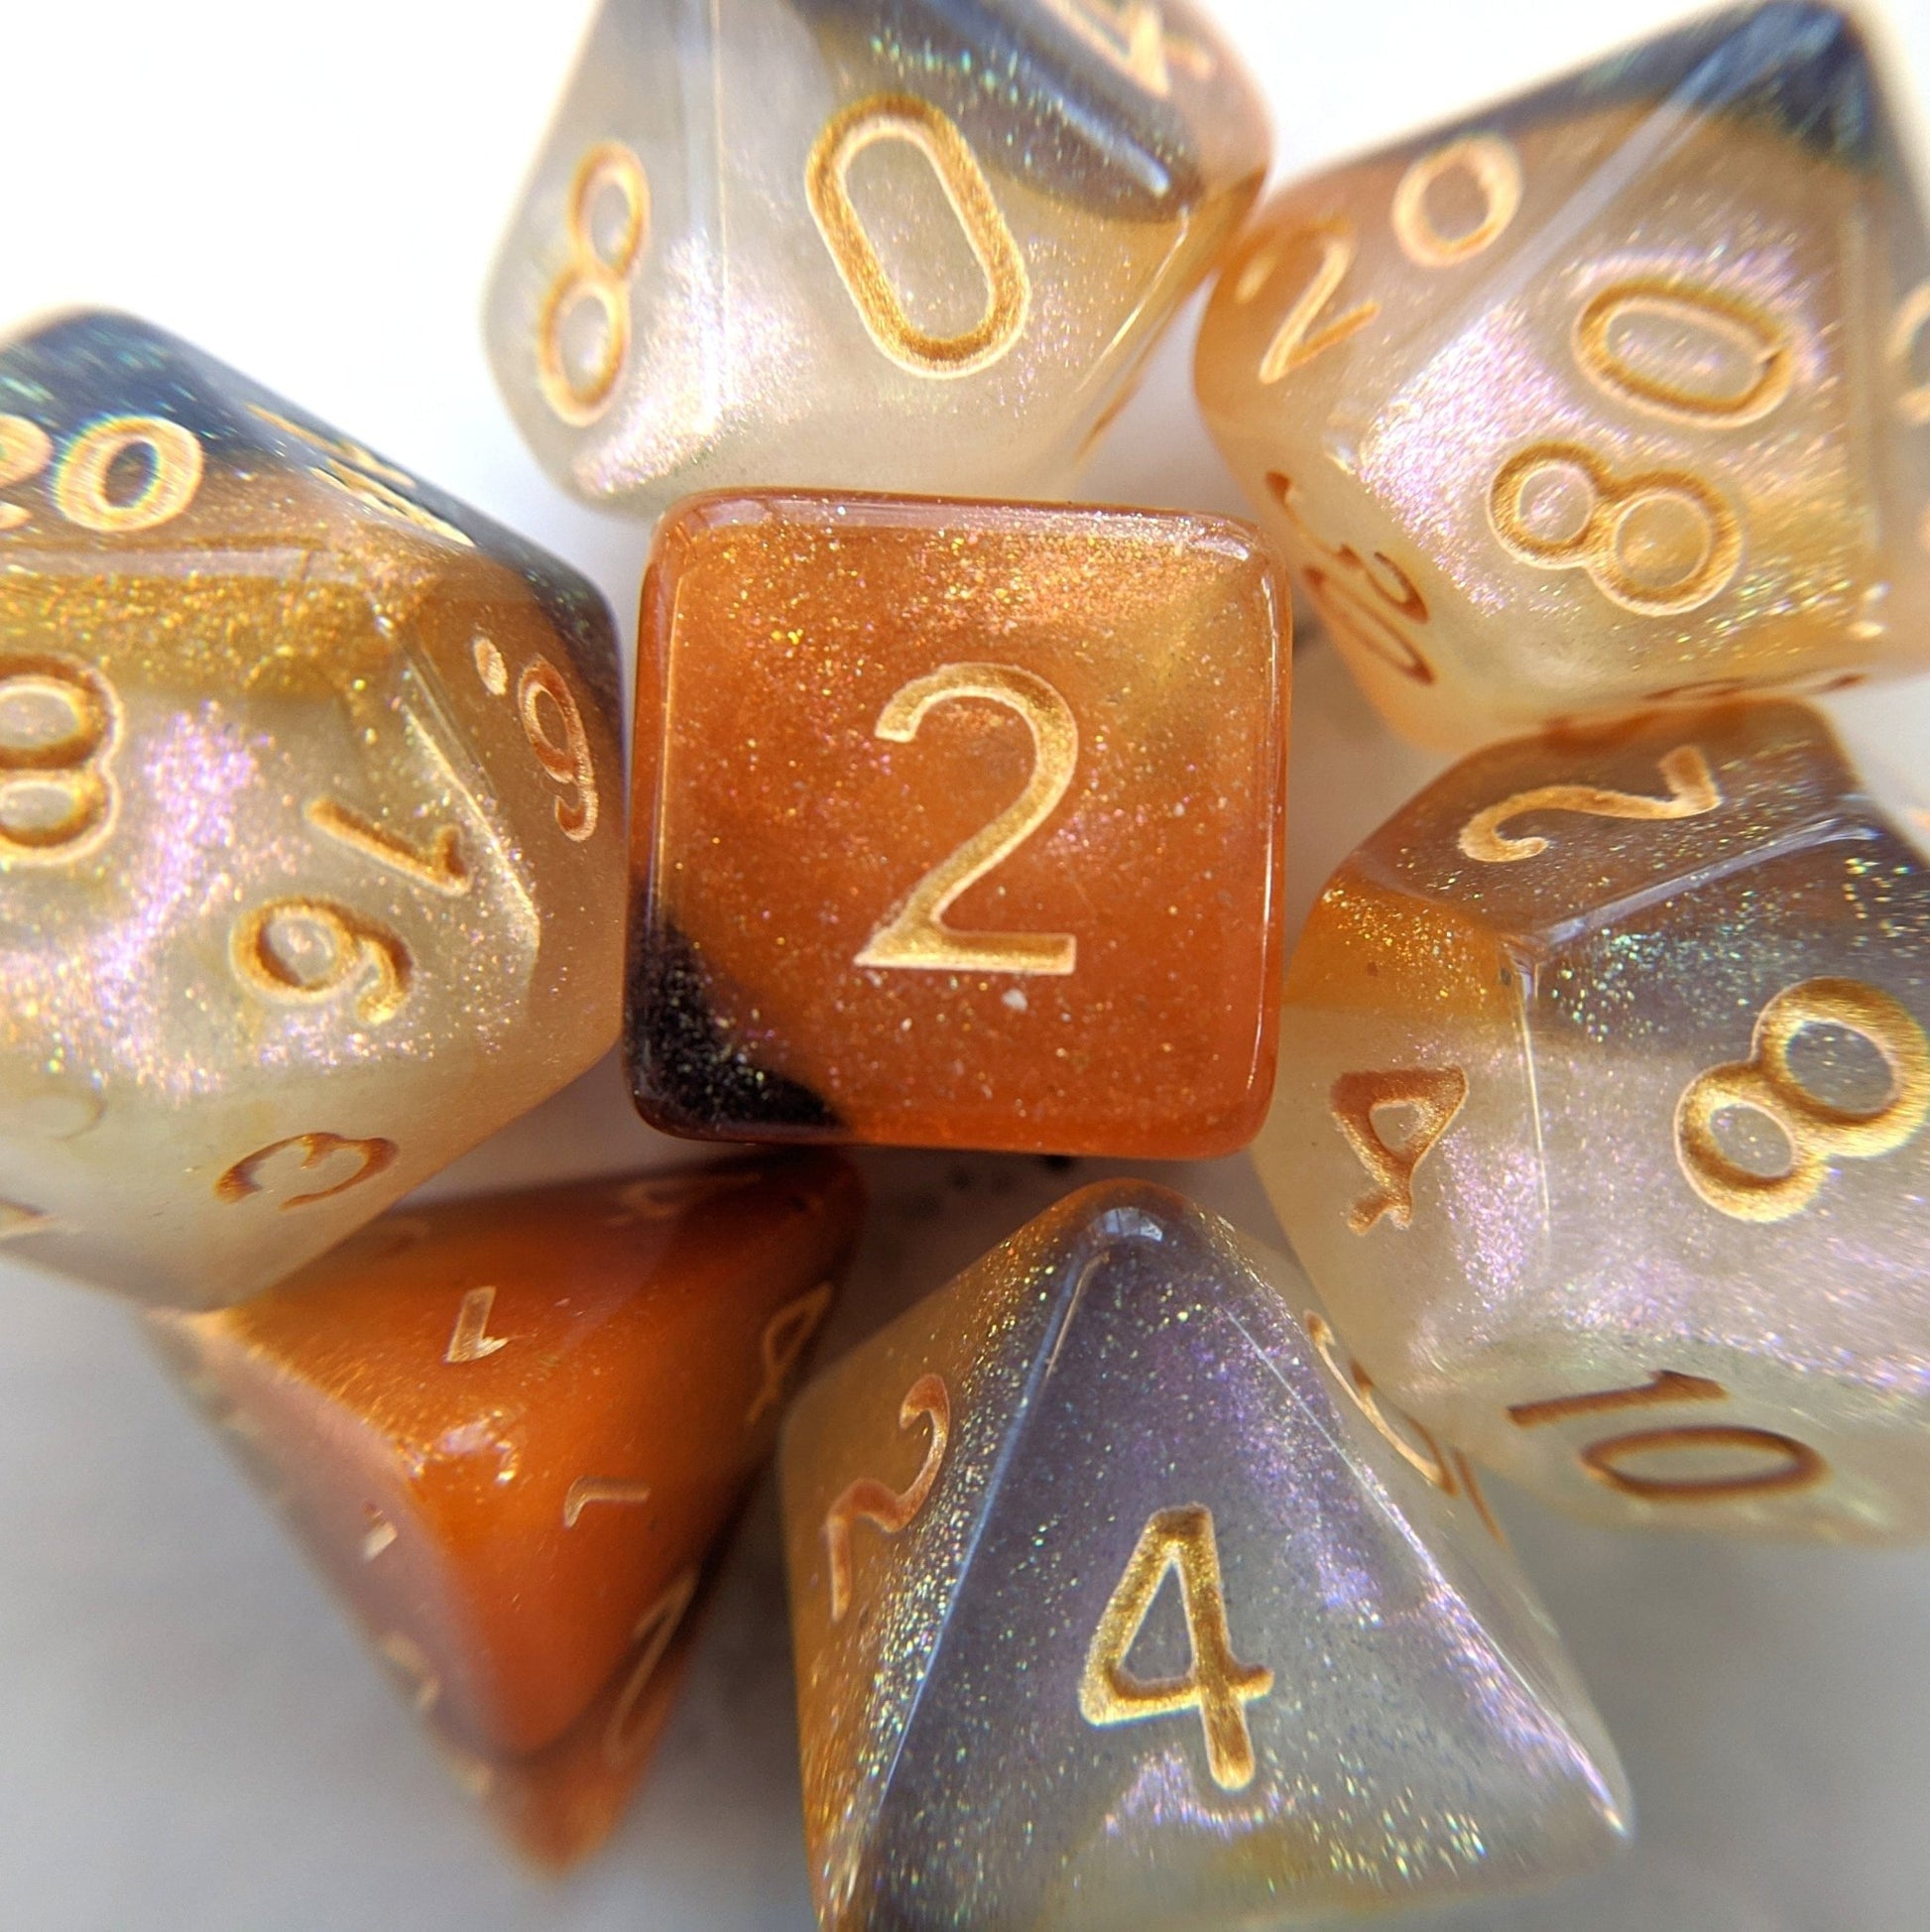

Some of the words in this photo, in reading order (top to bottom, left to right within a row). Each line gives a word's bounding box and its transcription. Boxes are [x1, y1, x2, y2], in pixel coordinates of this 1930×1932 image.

[536, 139, 652, 428] 8
[805, 92, 1031, 381] 0
[1488, 273, 1793, 617] 80
[853, 662, 1080, 975] 2
[1458, 745, 1724, 862] 2
[1329, 1064, 1469, 1236] 4
[1673, 975, 1930, 1223] 8
[1506, 1370, 1831, 1504] 10
[1078, 1502, 1274, 1791] 4
